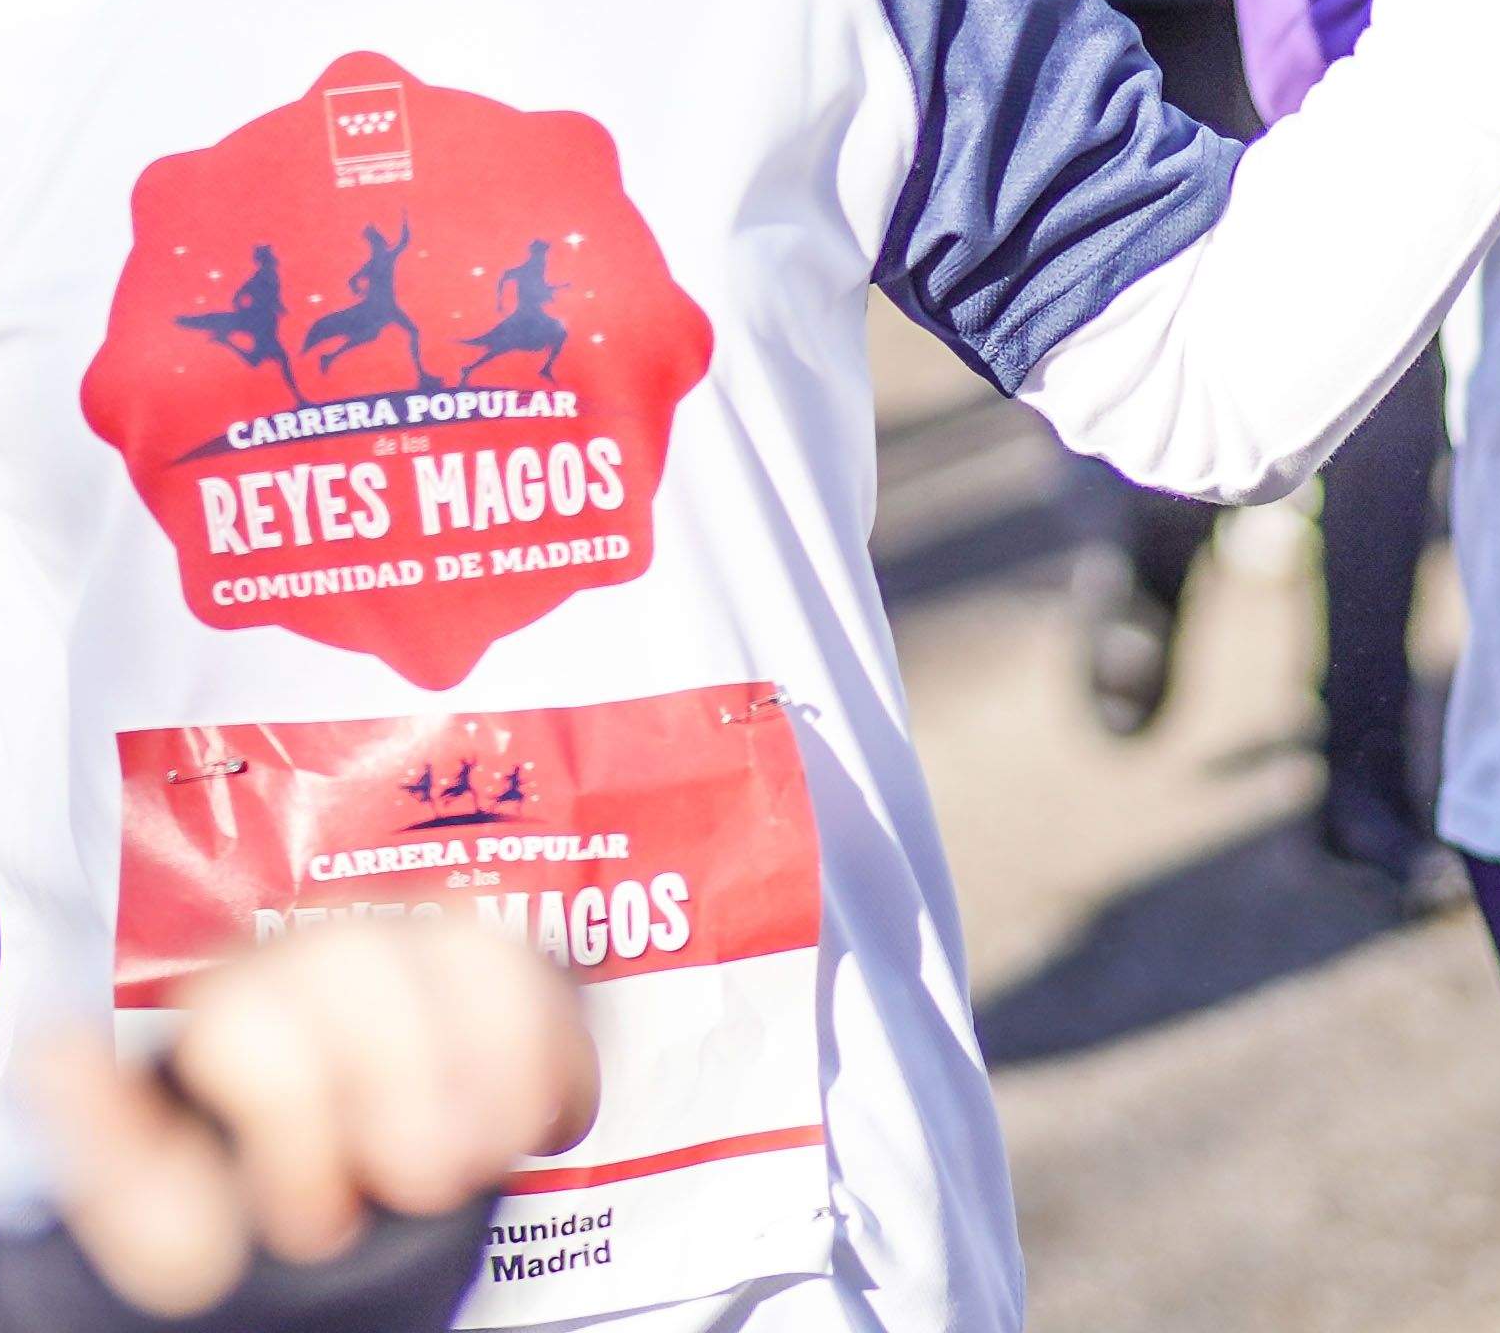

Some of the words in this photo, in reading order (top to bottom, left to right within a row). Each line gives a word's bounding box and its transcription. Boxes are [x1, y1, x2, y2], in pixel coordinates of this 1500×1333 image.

[227, 398, 398, 449] CARRERA
[406, 391, 577, 423] POPULAR
[197, 461, 392, 557] REYES
[413, 437, 625, 535] MAGOS
[211, 559, 425, 607] COMUNIDAD
[435, 552, 484, 583] DE
[490, 534, 630, 576] MADRID
[308, 838, 471, 883] CARRERA
[475, 832, 630, 864] POPULAR
[446, 869, 471, 889] de
[473, 867, 501, 887] los
[490, 1238, 613, 1284] Madrid
